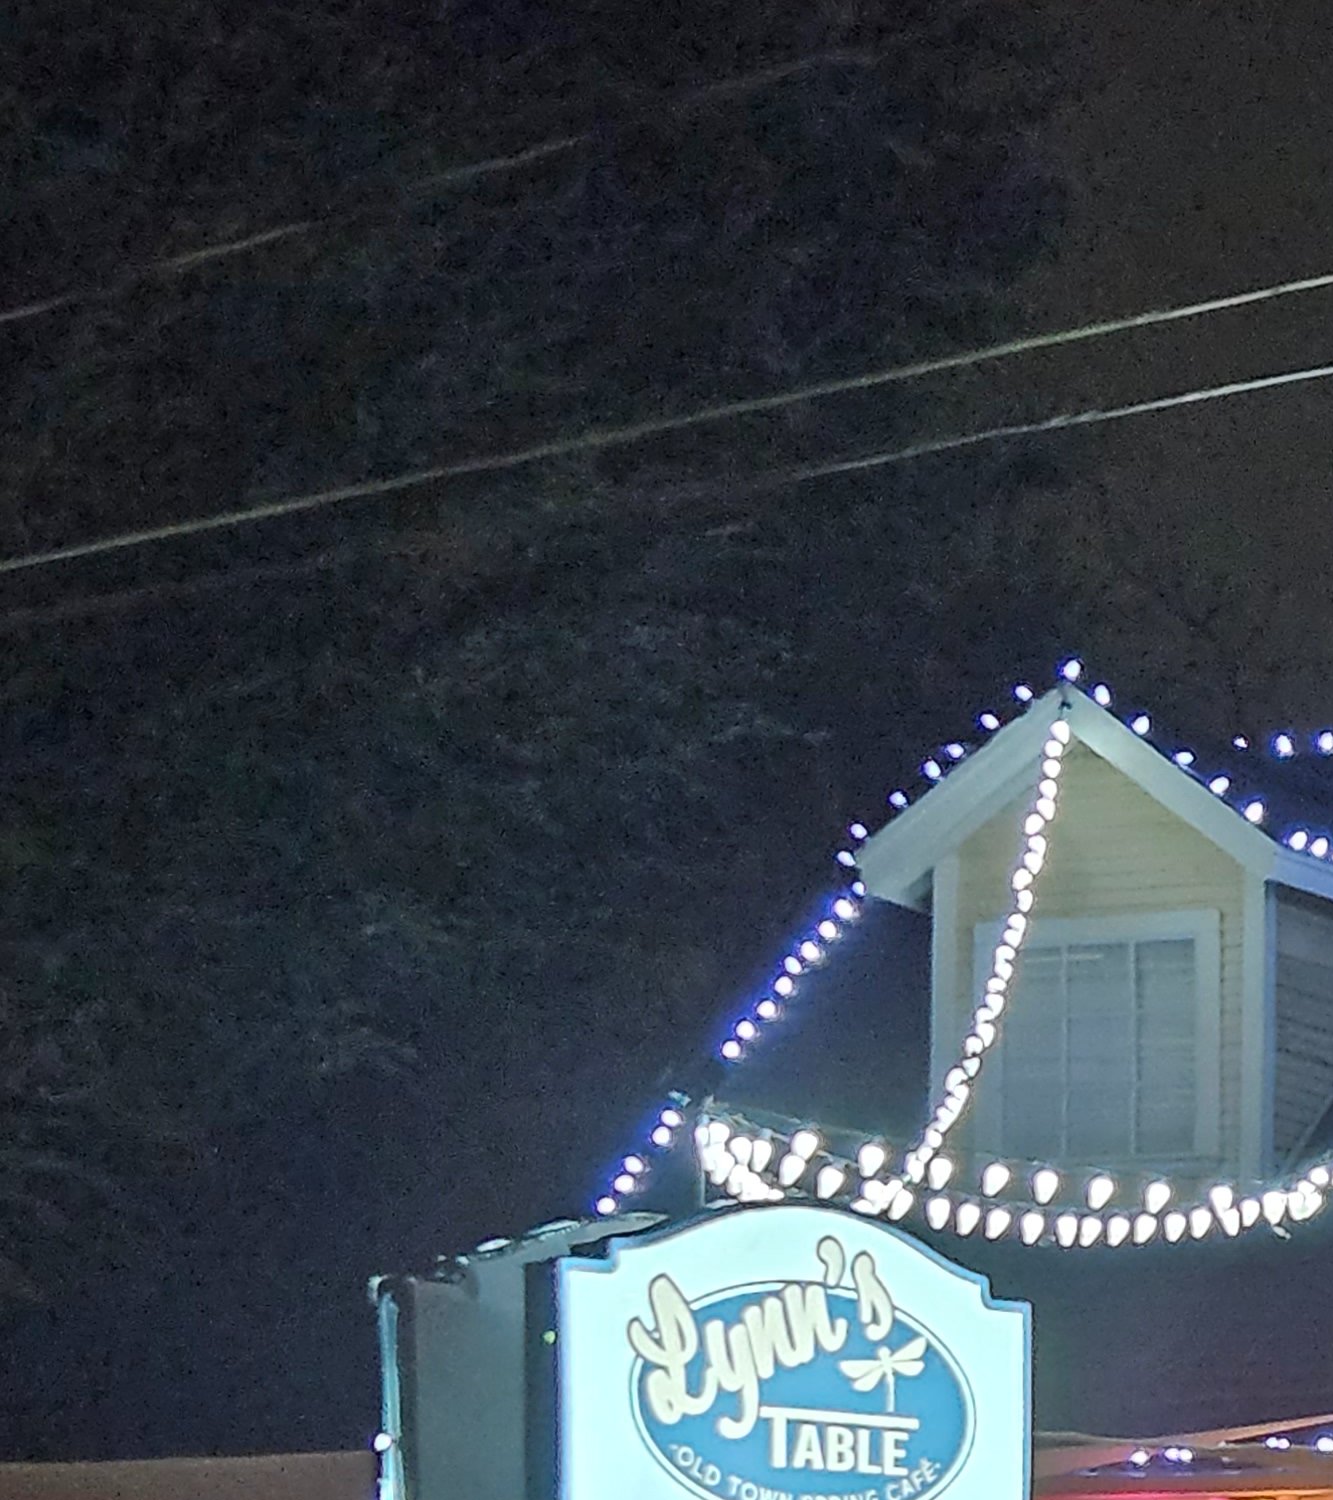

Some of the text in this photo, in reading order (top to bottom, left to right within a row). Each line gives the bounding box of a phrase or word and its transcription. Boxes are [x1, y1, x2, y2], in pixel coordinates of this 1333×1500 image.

[628, 1235, 894, 1439] Lynn's
[675, 1446, 721, 1486] OLD
[760, 1405, 919, 1476] TABLE
